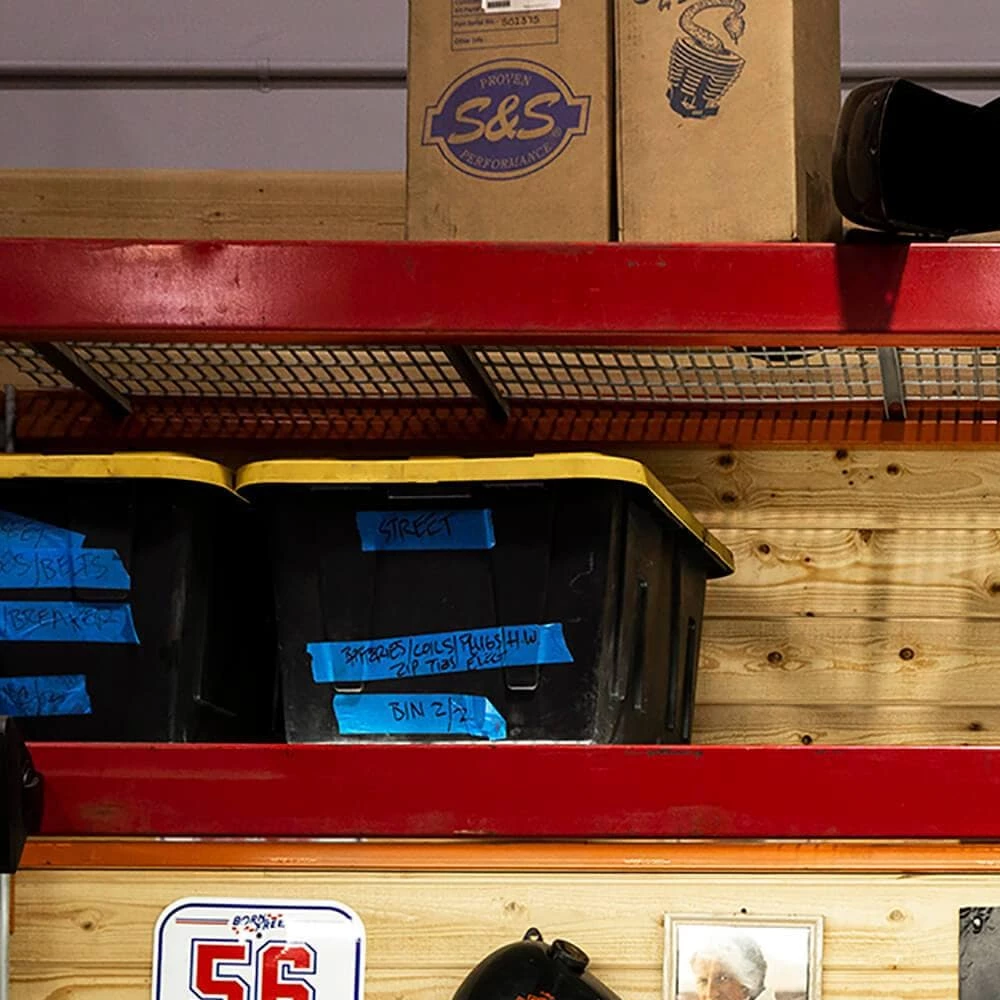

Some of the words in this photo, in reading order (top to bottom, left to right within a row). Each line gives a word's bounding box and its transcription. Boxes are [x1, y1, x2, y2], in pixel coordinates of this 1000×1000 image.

[479, 73, 532, 89] PROVEN
[448, 91, 560, 144] S&S
[459, 145, 552, 169] PERFORMANCE
[388, 701, 425, 721] BIN
